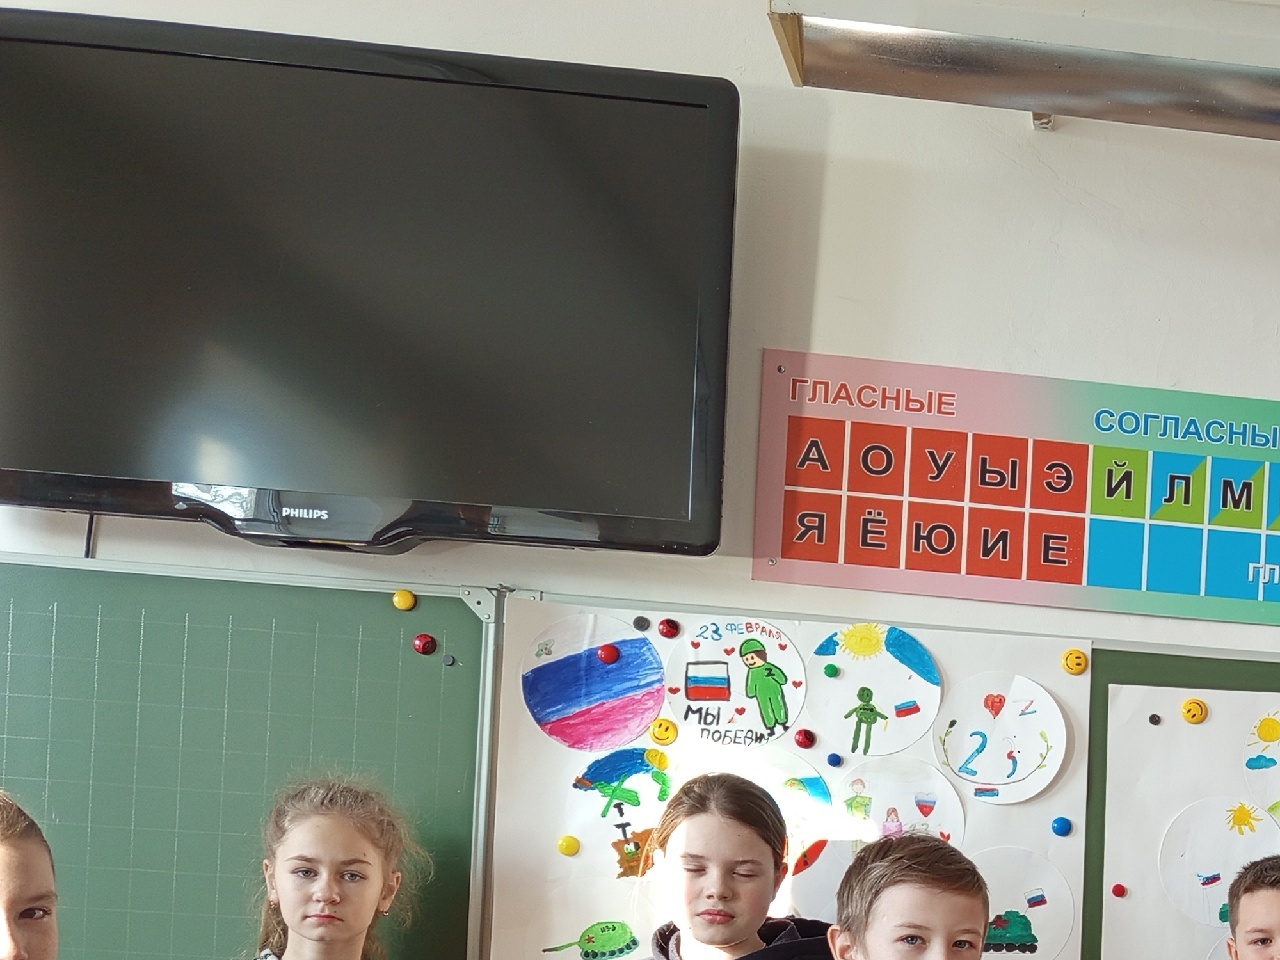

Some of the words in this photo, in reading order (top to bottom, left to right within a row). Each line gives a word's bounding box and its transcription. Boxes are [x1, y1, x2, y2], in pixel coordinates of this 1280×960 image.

[790, 377, 957, 417] ГЛАСНЫЕ
[796, 438, 831, 473] А
[860, 443, 895, 478] О
[926, 449, 955, 482] У
[979, 456, 1018, 491] Ы
[1043, 461, 1074, 495] Э
[1106, 461, 1133, 500] Й
[1162, 472, 1193, 506] Л
[1219, 479, 1255, 513] М
[282, 508, 329, 519] PHILIPS
[794, 510, 826, 544] Я
[860, 509, 888, 549] Ё
[913, 521, 956, 556] Ю
[980, 528, 1009, 560] И
[1042, 533, 1069, 567] Е
[696, 622, 722, 641] 23
[726, 622, 782, 641] ФЕВРАЛЯ
[684, 705, 721, 726] МЫ
